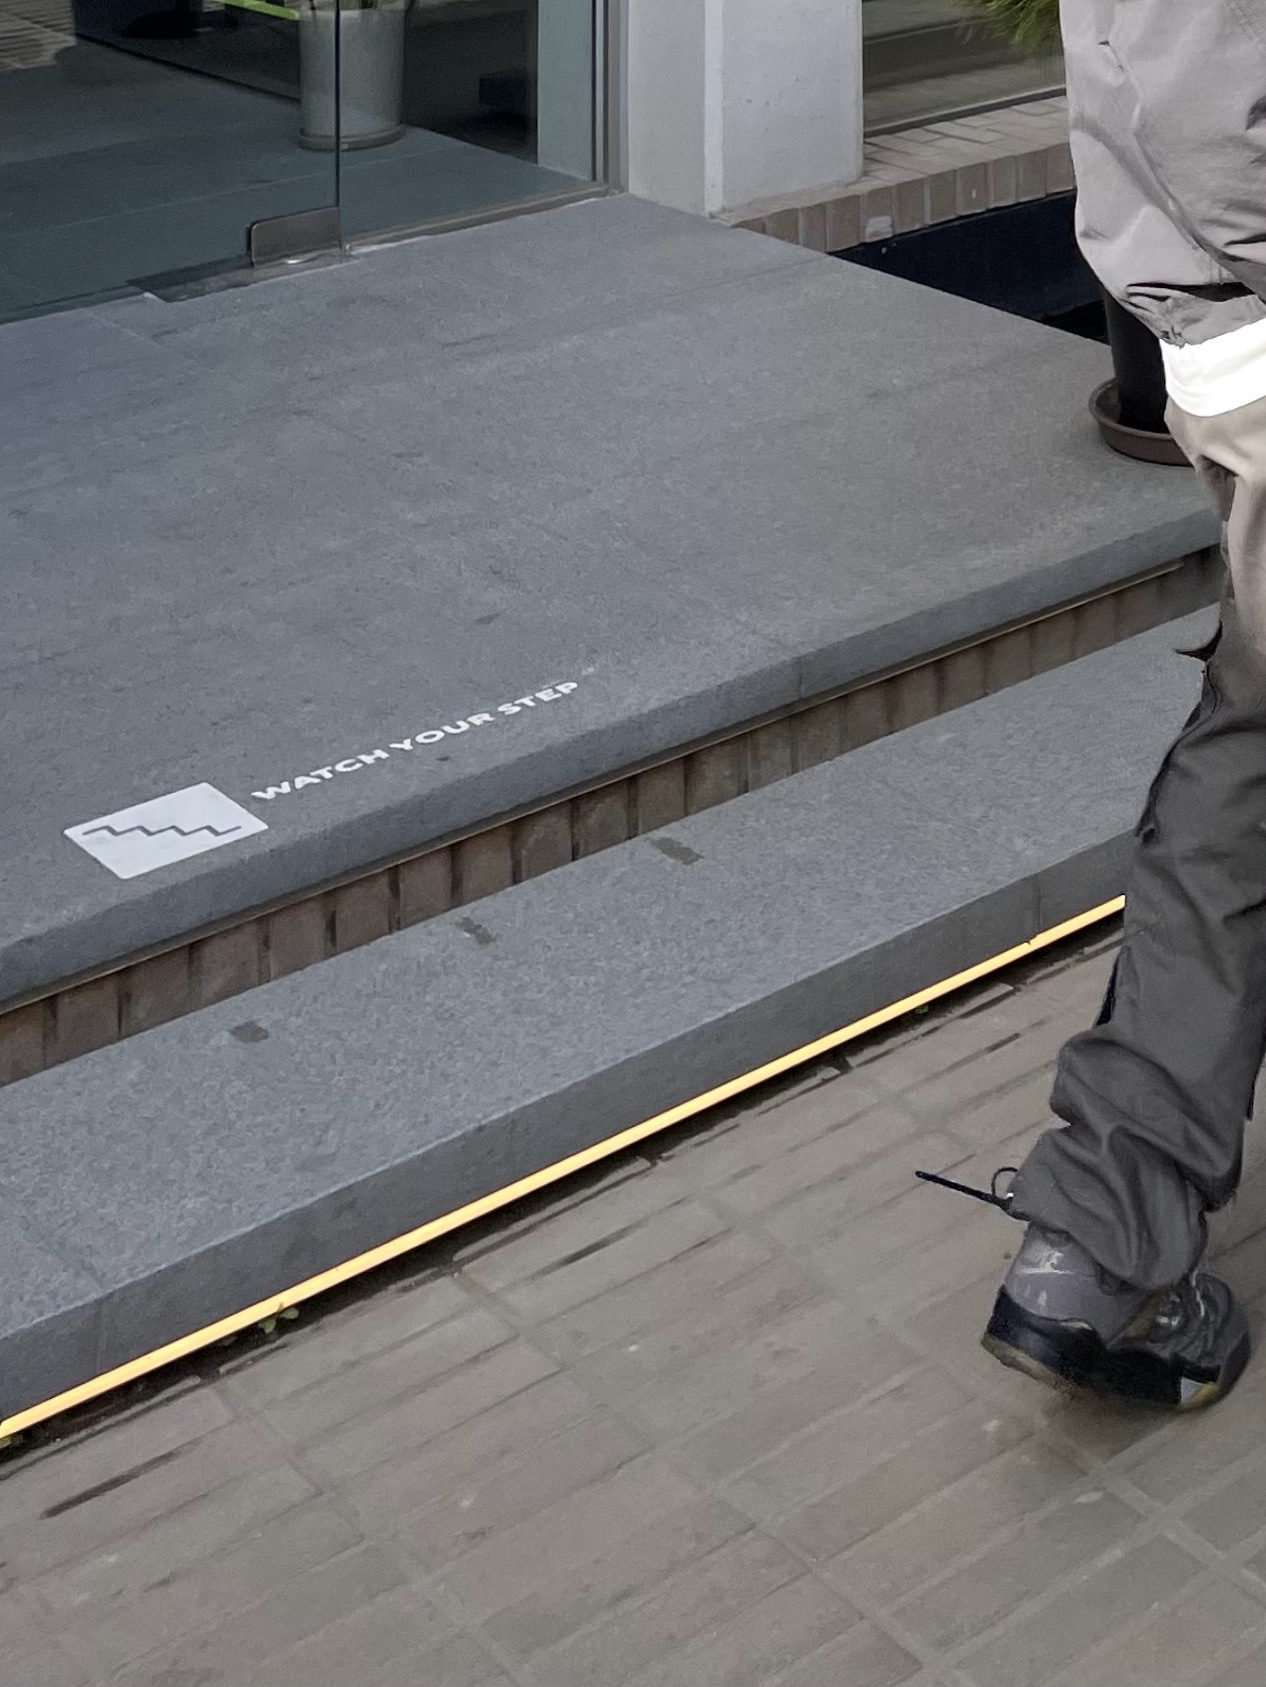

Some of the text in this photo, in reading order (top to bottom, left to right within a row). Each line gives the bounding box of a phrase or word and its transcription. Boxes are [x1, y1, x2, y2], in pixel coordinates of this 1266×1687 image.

[250, 681, 578, 800] WATCH YOUR STEP
